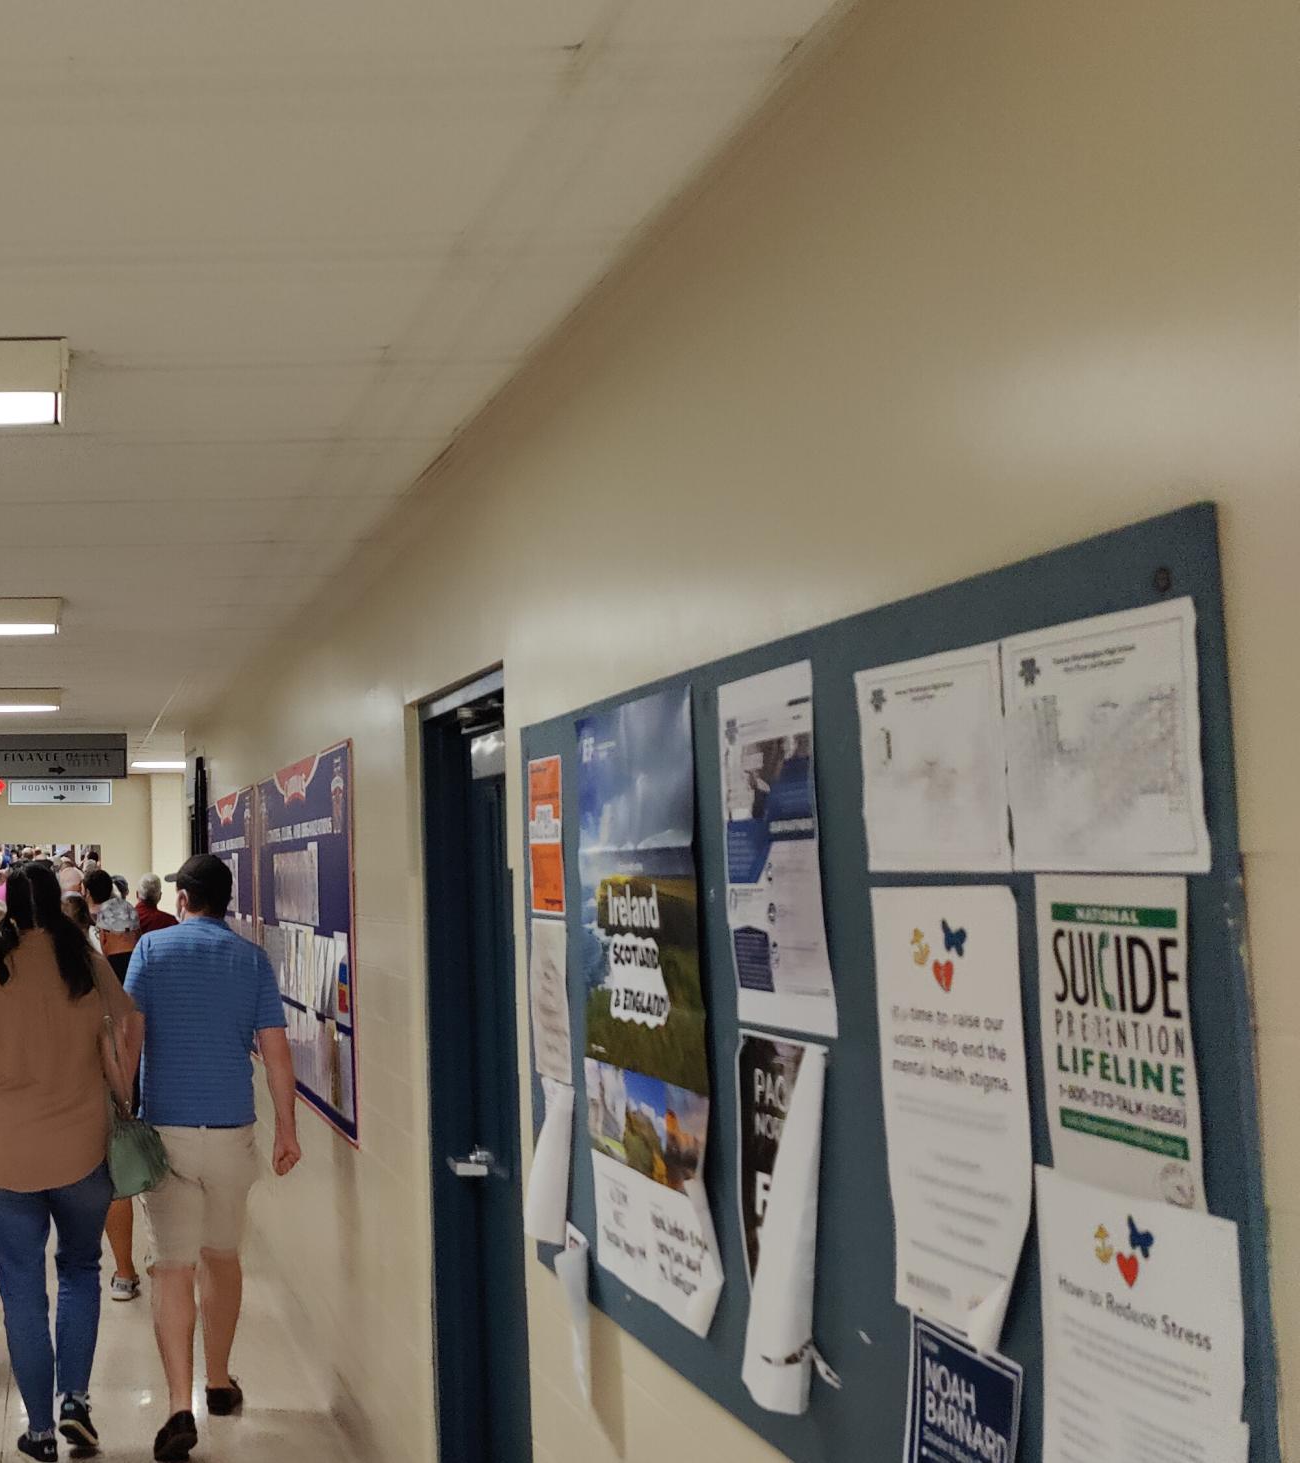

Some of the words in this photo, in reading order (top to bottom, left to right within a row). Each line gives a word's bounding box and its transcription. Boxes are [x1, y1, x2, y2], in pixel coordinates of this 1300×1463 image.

[3, 752, 58, 762] FINANCE
[21, 784, 54, 792] ROOMS
[607, 883, 660, 929] Ireland
[613, 942, 659, 970] SCOTLAND
[1052, 928, 1183, 1019] SUICIDE
[623, 987, 668, 1017] ENGLAND
[983, 1016, 1005, 1031] our
[1054, 1008, 1186, 1058] PREVENTION
[931, 1036, 959, 1057] Help
[961, 1041, 985, 1058] end
[987, 1042, 1007, 1061] the
[892, 1058, 926, 1076] mental
[931, 1064, 965, 1083] health
[1056, 1043, 1186, 1097] LIFELINE
[1058, 1274, 1085, 1298] How
[1105, 1291, 1157, 1330] Reduce
[1161, 1313, 1212, 1351] Stress
[924, 1356, 977, 1417] NOAH
[924, 1389, 1008, 1463] BARNARD
